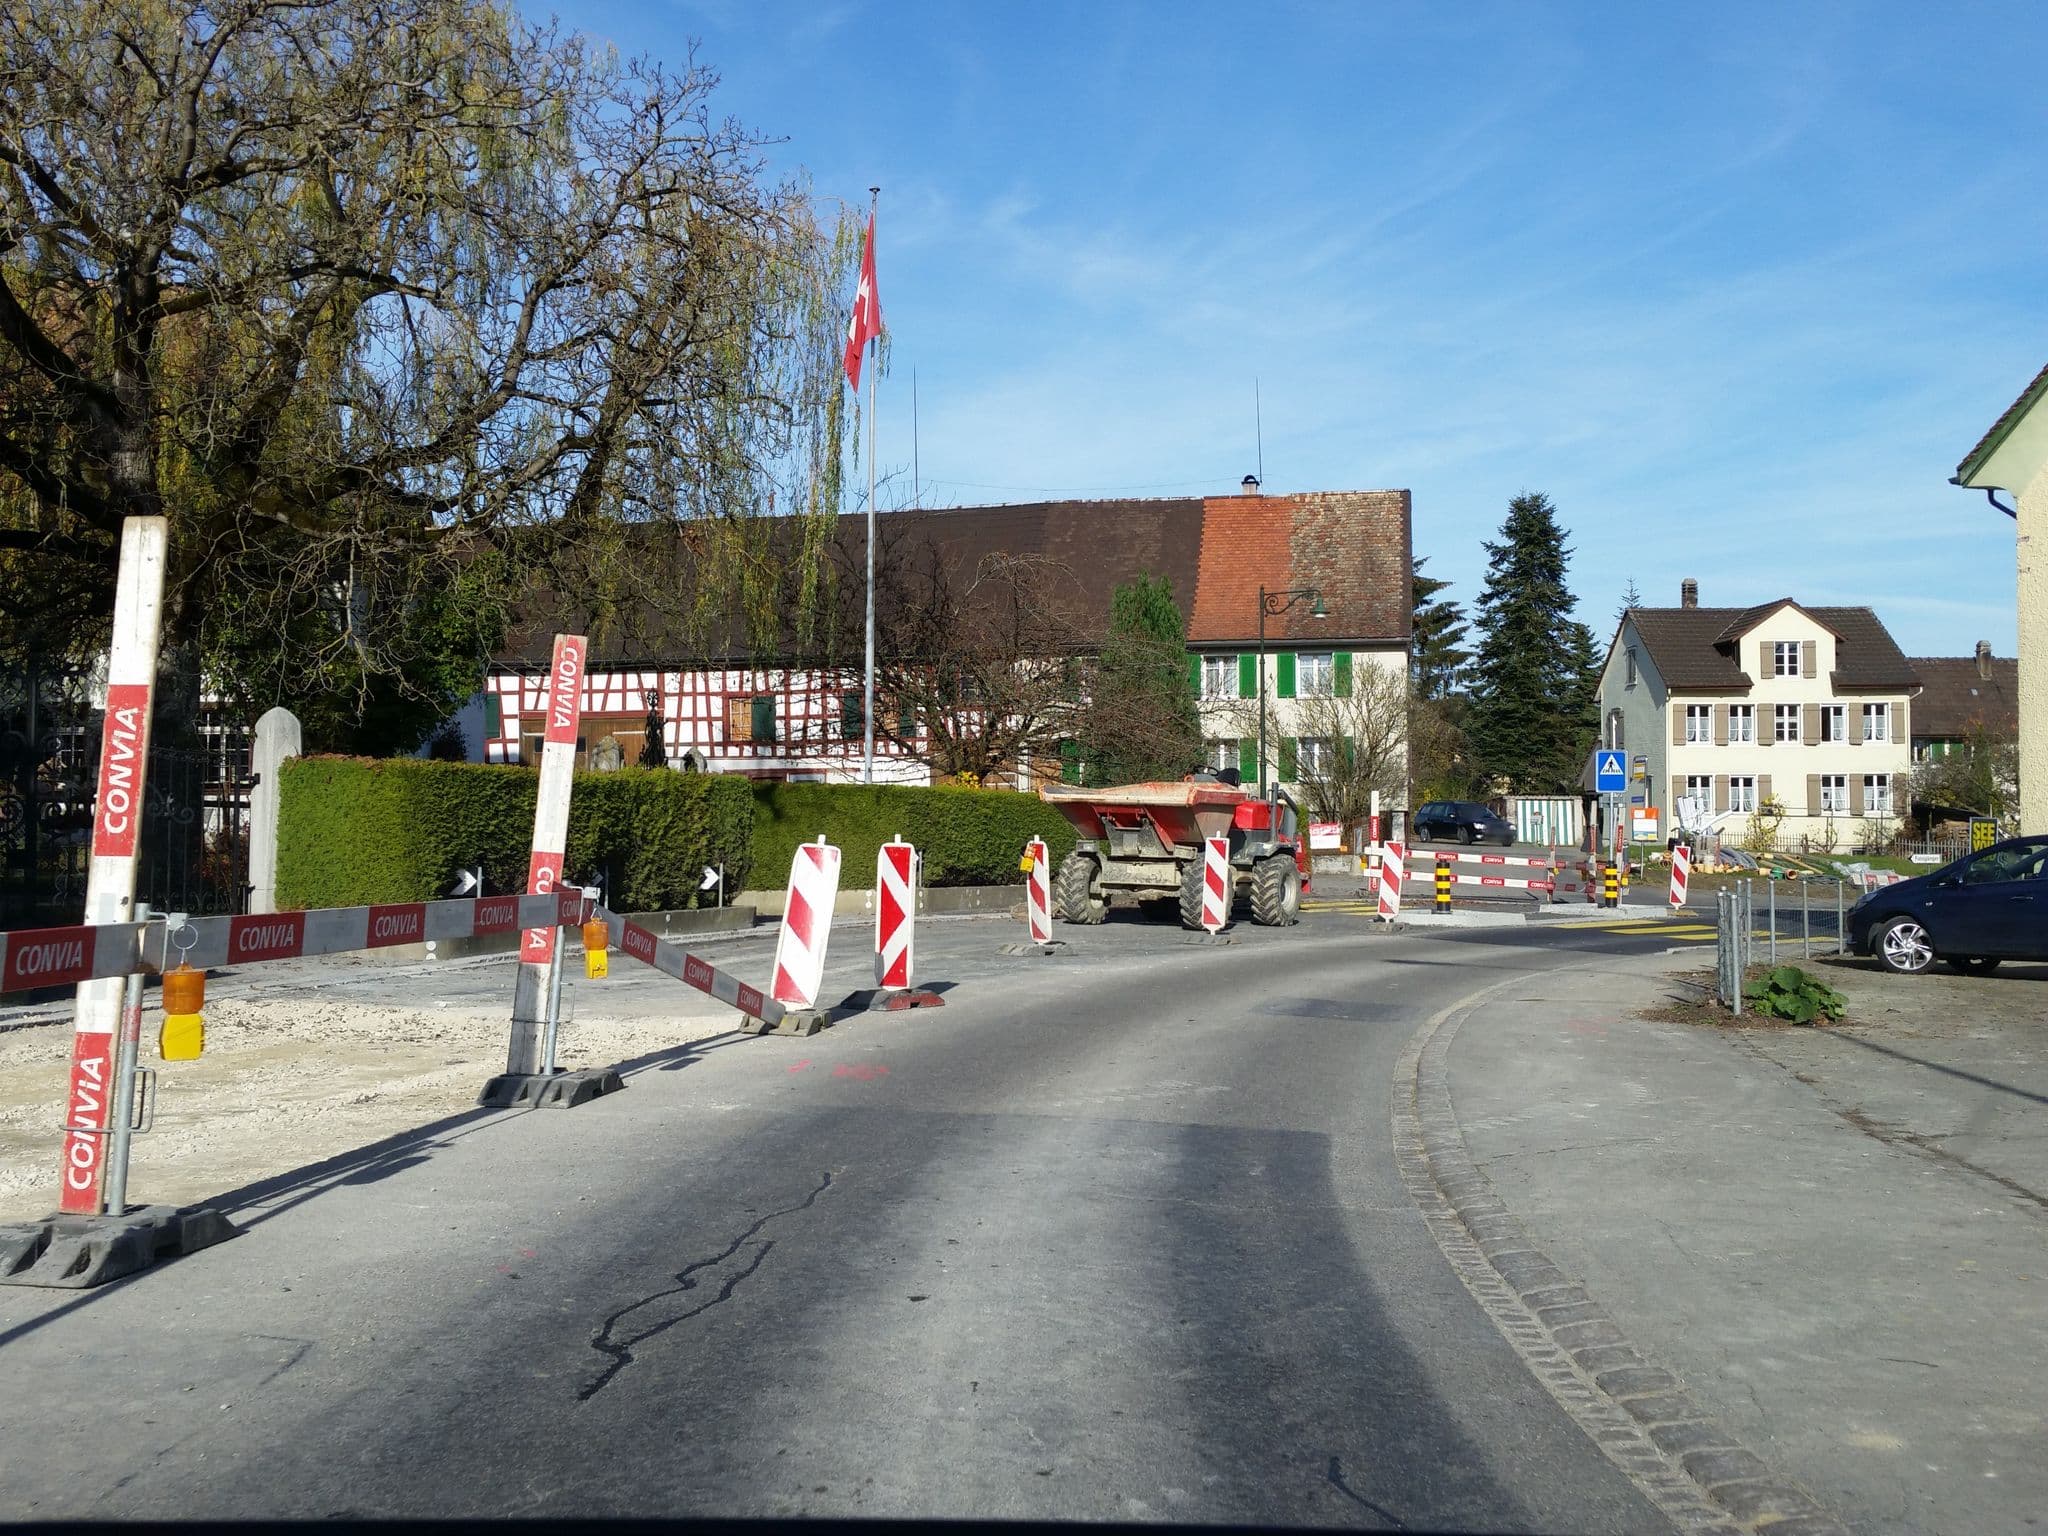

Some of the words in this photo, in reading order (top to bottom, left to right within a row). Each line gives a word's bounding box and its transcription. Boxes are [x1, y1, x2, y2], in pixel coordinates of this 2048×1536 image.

[553, 647, 578, 728] CONVIA
[104, 707, 139, 834] CONVIA
[1972, 822, 1995, 840] SEE
[375, 913, 418, 938] CONVIA
[480, 905, 513, 926] CONVIA
[239, 923, 295, 951] CONVIA
[626, 929, 652, 953] CONVIA
[15, 940, 82, 976] CONVIA
[687, 963, 711, 986] CONVIA
[741, 989, 761, 1009] CONVIA
[68, 1056, 104, 1190] CONVIA
